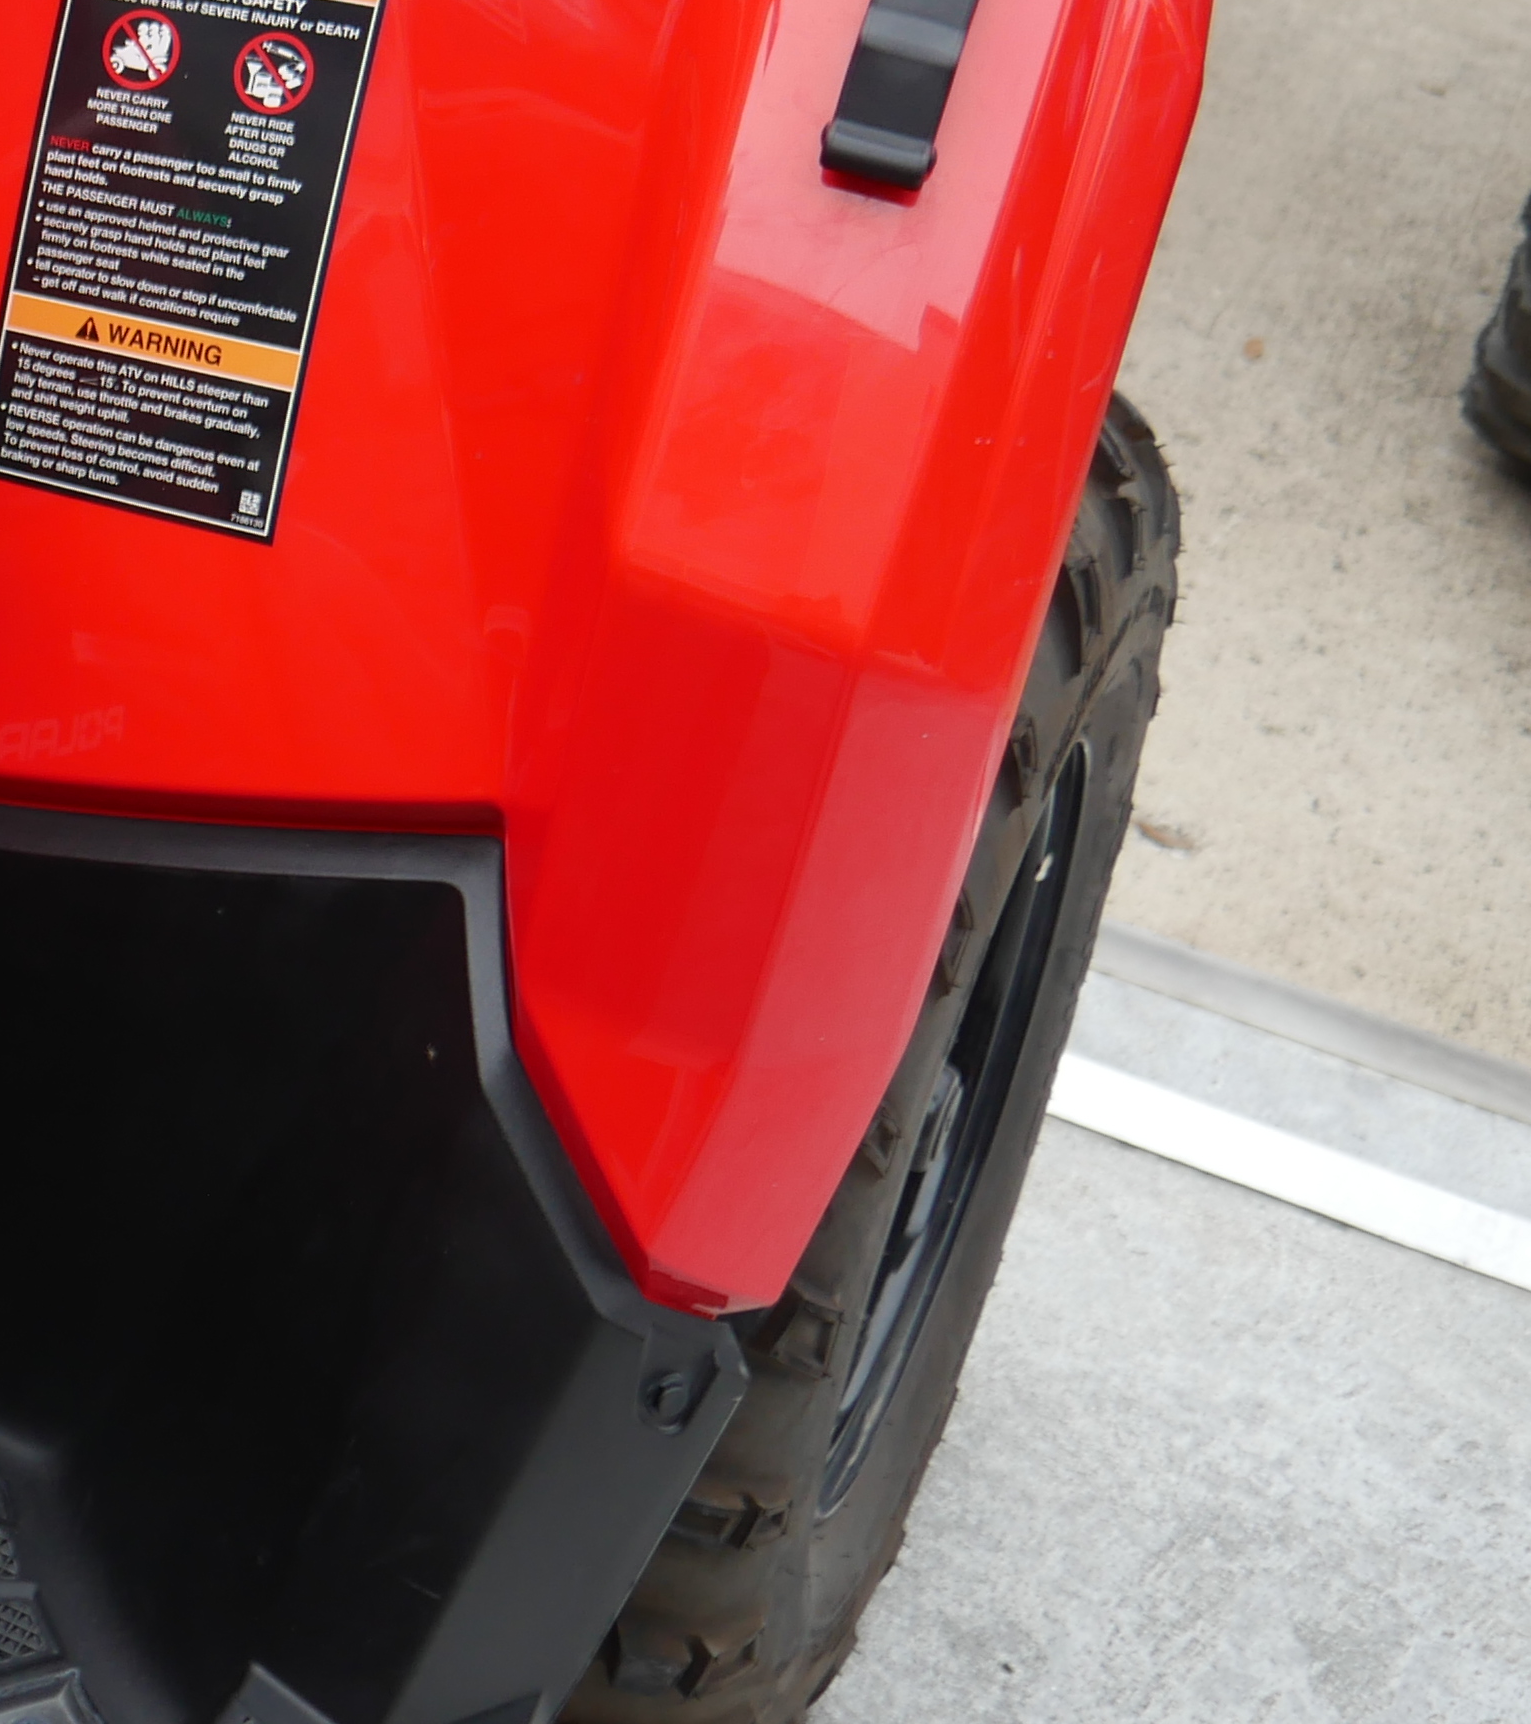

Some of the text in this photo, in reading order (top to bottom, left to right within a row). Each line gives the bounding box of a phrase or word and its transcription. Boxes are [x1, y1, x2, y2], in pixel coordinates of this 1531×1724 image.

[185, 0, 198, 14] of
[200, 3, 248, 22] SEVERE
[251, 11, 297, 30] INJURY
[300, 21, 312, 32] or
[315, 21, 359, 40] DEATH
[87, 97, 172, 124] MORE THAN ONE
[96, 86, 168, 110] NEVER CARRY
[95, 112, 157, 134] PASSENGER
[224, 123, 294, 147] AFTER USING
[231, 111, 294, 133] NEVER RIDE
[50, 134, 301, 195] NEVER carry a passenger too small to firmly
[228, 137, 285, 158] DRUGS OR
[228, 150, 279, 171] ALCOHOL
[44, 163, 108, 187] hand holds.
[46, 148, 283, 207] plant feet on footrests and securely grasp
[40, 180, 64, 196] THE
[65, 185, 137, 211] PASSENGER
[139, 199, 174, 218] MUST
[42, 214, 266, 270] securely grasp hand holds and plant feet
[46, 201, 288, 262] use an approved helmet and protective gear
[36, 245, 119, 271] passenger seat
[35, 258, 296, 323] tell operator to slow down or stop if uncomfortable
[40, 274, 239, 330] get off and walk if conditions require
[107, 323, 223, 367] WARNING
[16, 356, 30, 370] 15
[31, 360, 76, 383] degrees
[121, 380, 136, 394] To
[137, 384, 180, 407] prevent
[182, 393, 230, 415] overturn
[231, 407, 247, 419] on
[19, 342, 269, 408] Never operate this ATV on HILLS steeper than
[8, 403, 259, 473] REVERSE operation can be dangerous even at
